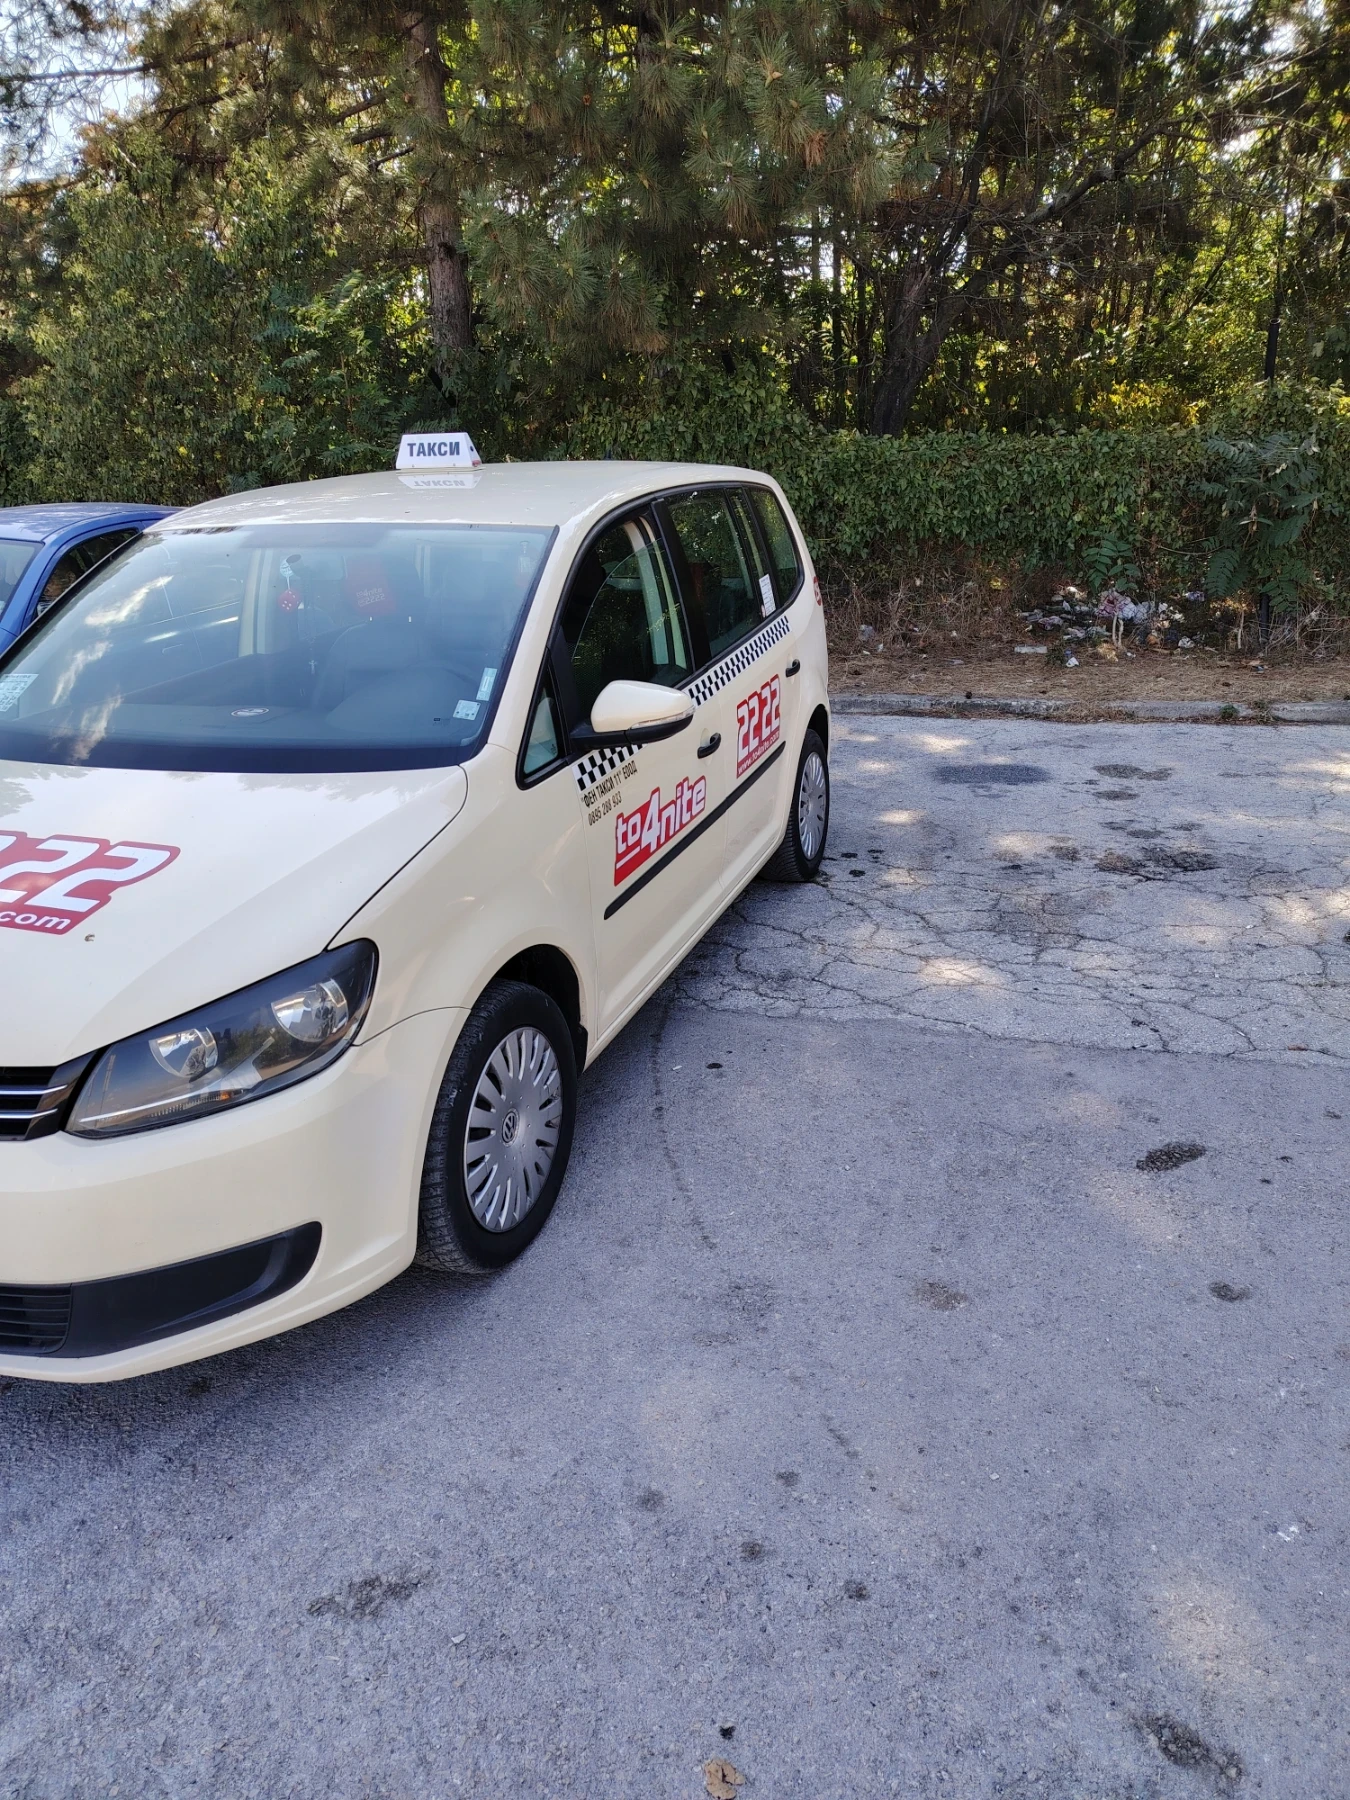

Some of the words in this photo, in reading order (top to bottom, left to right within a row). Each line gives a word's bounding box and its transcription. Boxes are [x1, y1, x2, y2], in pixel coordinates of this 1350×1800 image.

[407, 441, 460, 457] ТАКСИ
[596, 776, 615, 798] ТАКСИ
[622, 760, 638, 780] ЕООД
[616, 775, 706, 855] to4nite
